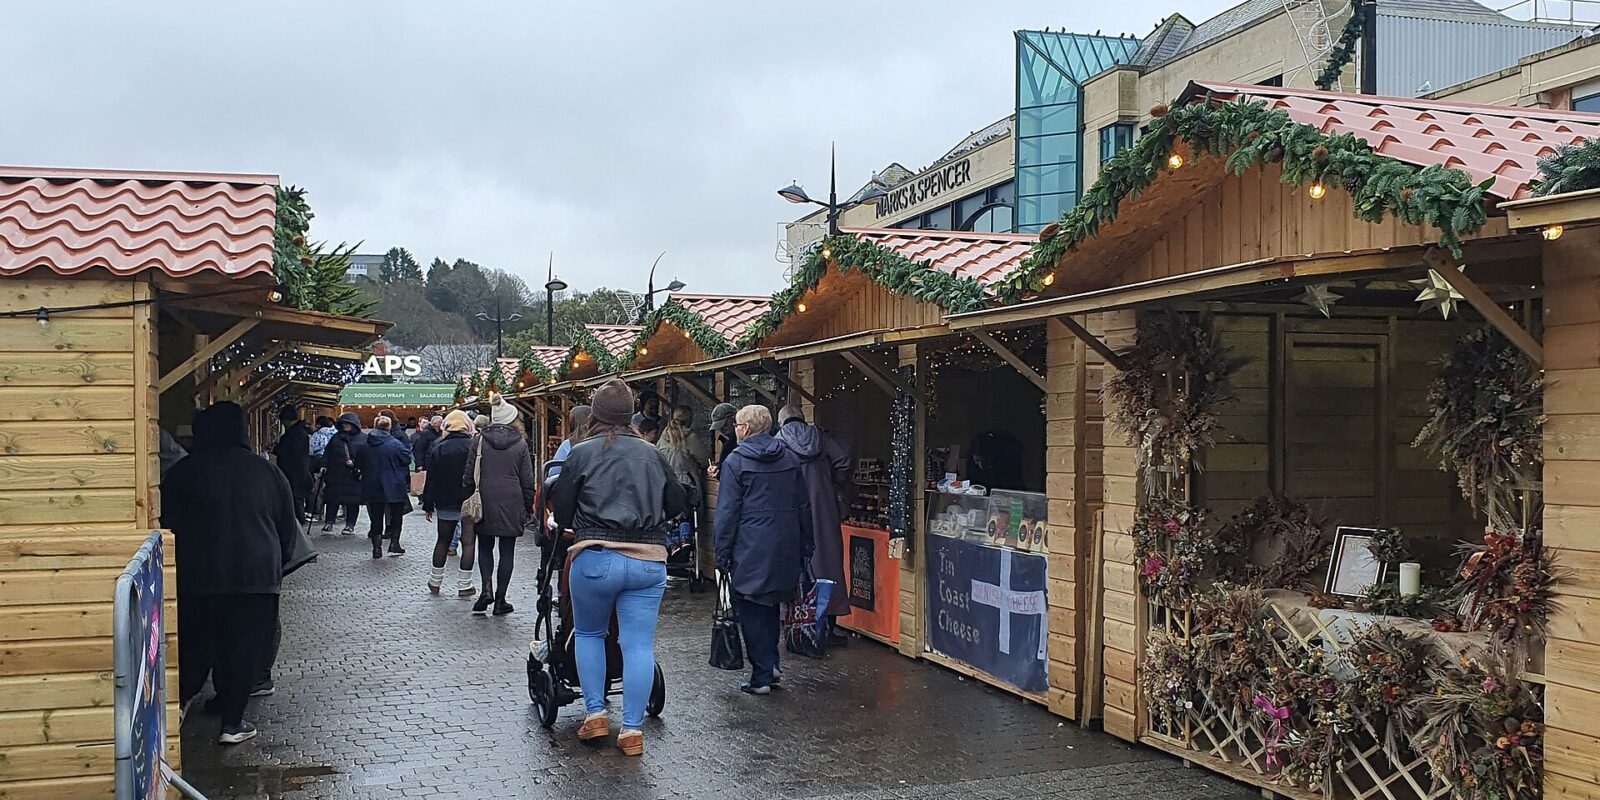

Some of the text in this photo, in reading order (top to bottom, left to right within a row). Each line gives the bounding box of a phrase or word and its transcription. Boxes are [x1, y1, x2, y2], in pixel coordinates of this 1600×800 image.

[876, 158, 971, 219] MARKS & SPENCER
[938, 551, 955, 577] Tin
[938, 579, 970, 611] Coast
[938, 609, 980, 644] Cheese
